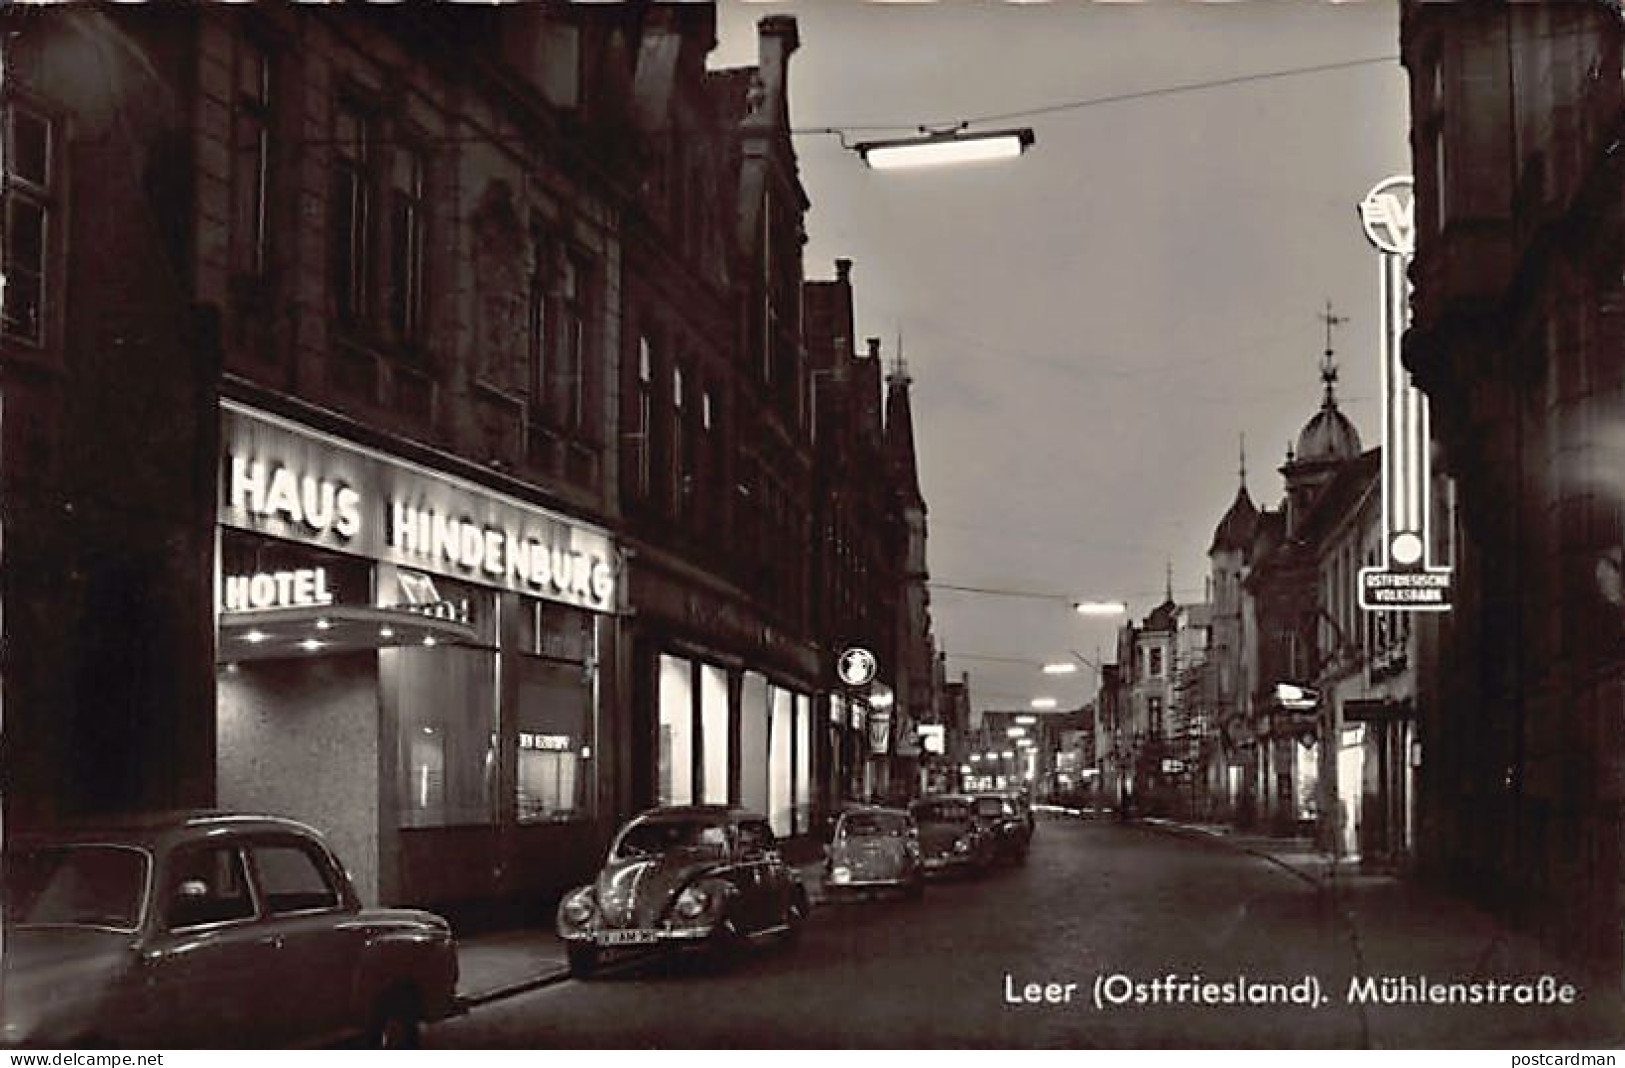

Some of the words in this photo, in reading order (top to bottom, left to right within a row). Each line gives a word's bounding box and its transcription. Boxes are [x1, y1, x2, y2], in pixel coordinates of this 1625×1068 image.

[231, 456, 361, 538] HAUS
[393, 501, 614, 609] HINDENBURG
[226, 567, 333, 609] HOTEL
